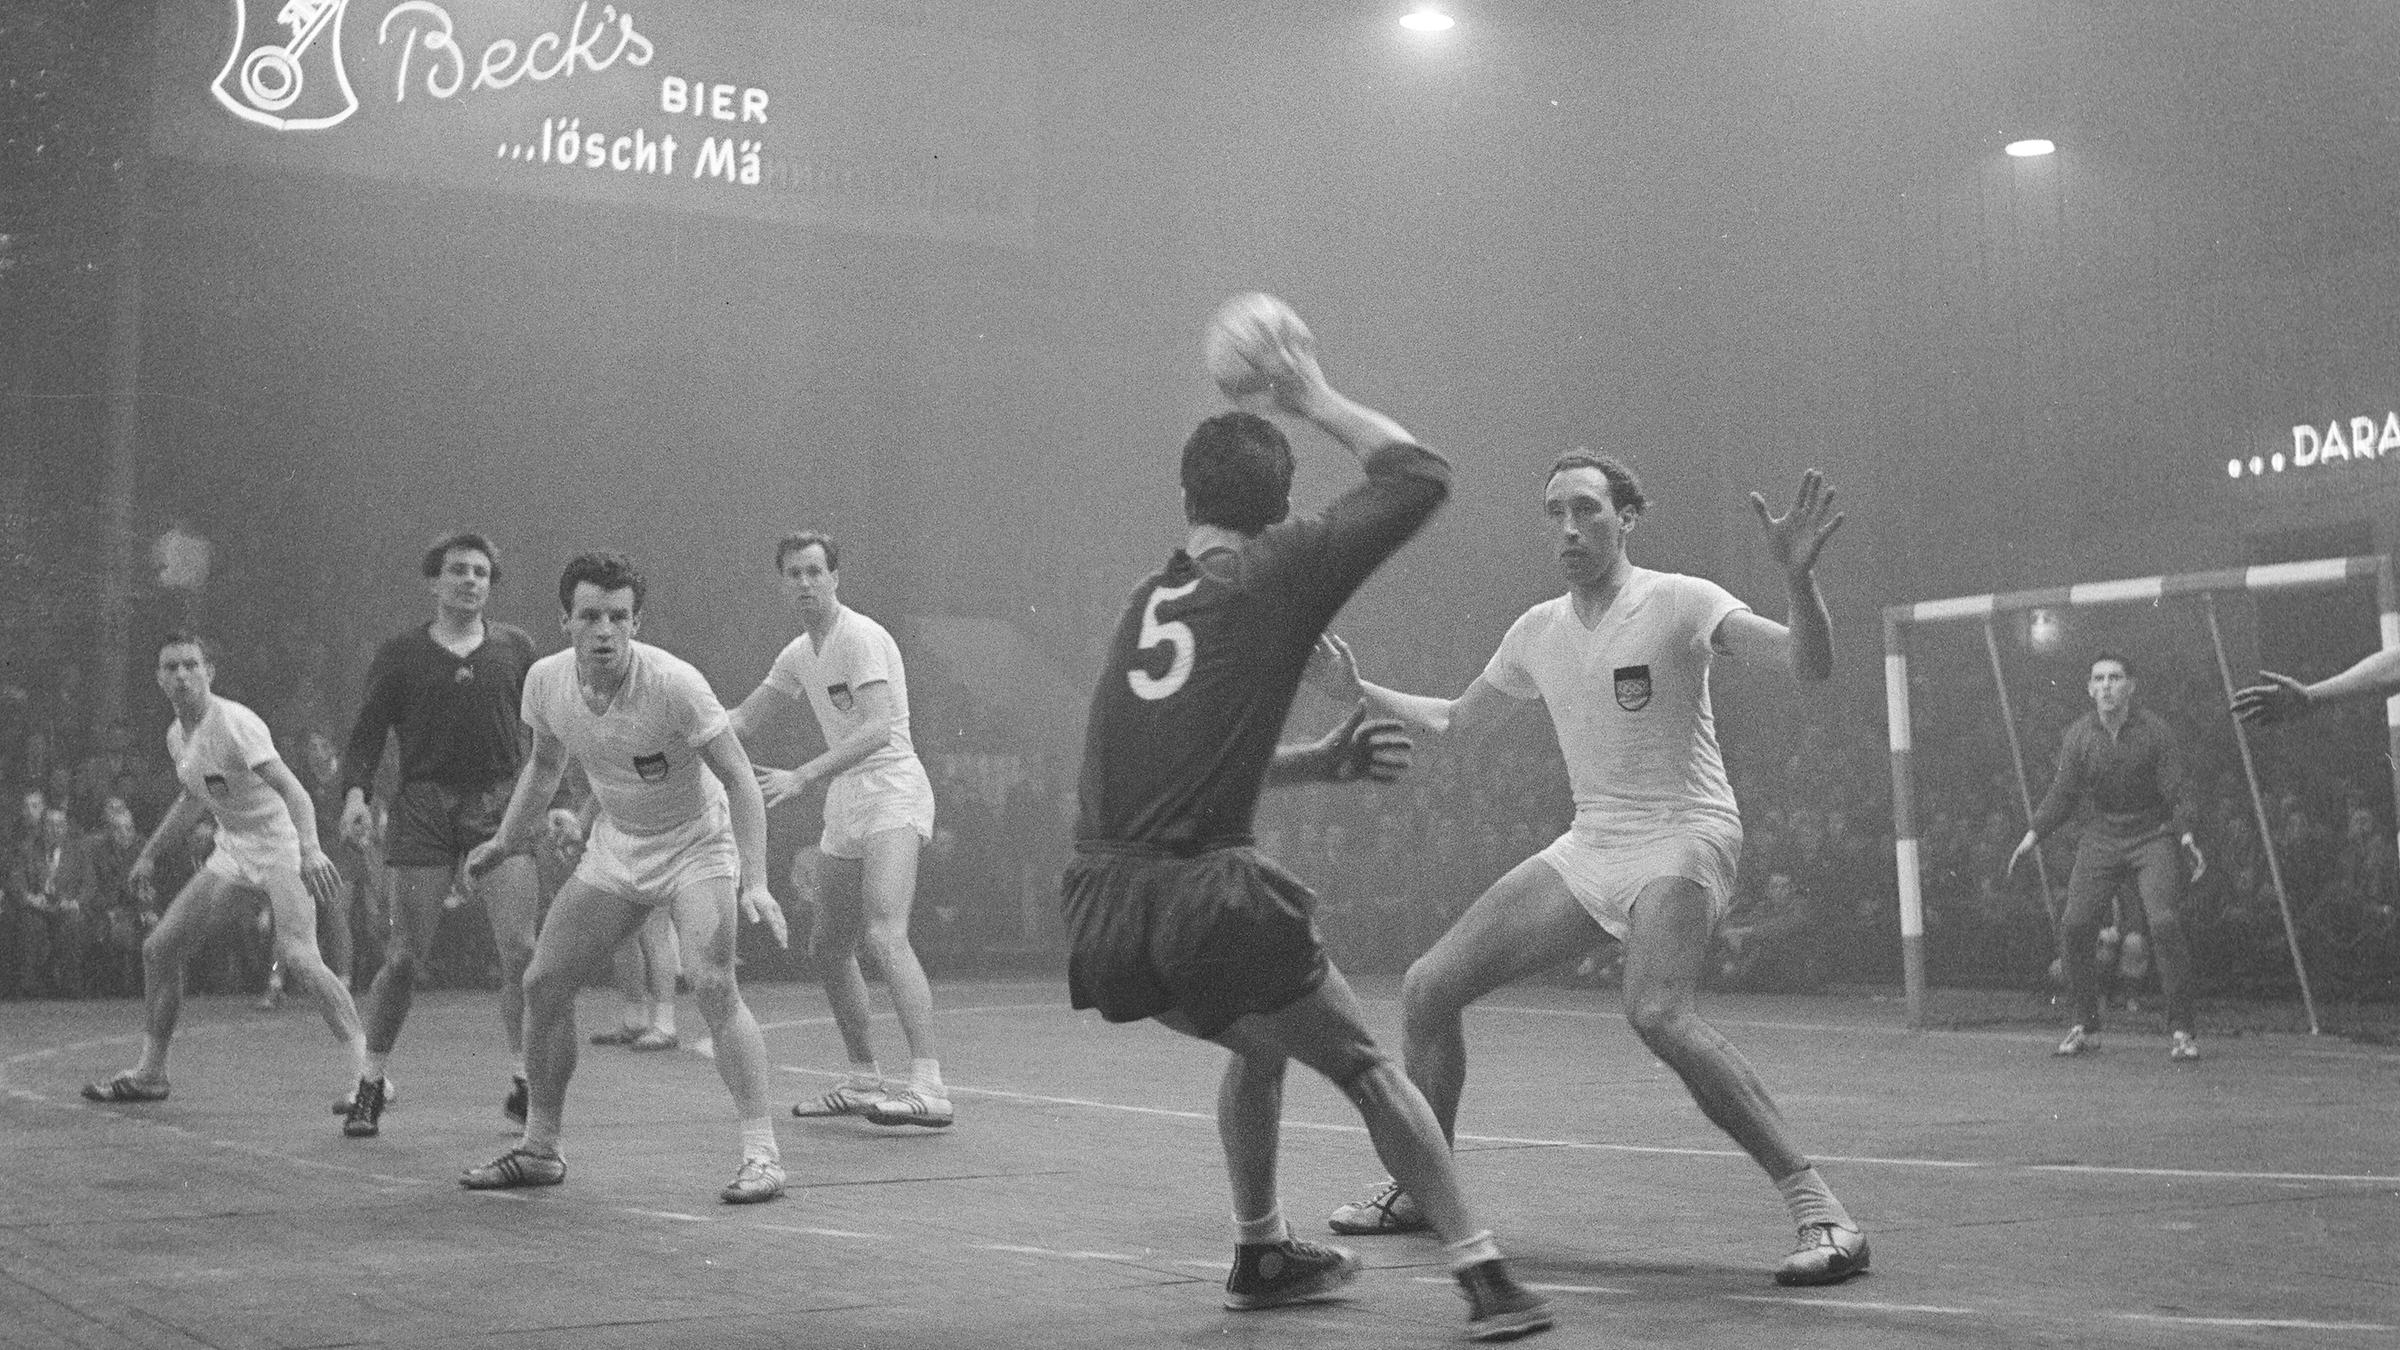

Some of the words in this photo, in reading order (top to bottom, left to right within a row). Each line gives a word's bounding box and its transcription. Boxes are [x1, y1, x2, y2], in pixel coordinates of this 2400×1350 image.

[379, 0, 654, 102] Beck's
[660, 76, 768, 124] BIER
[1127, 578, 1202, 700] 5
